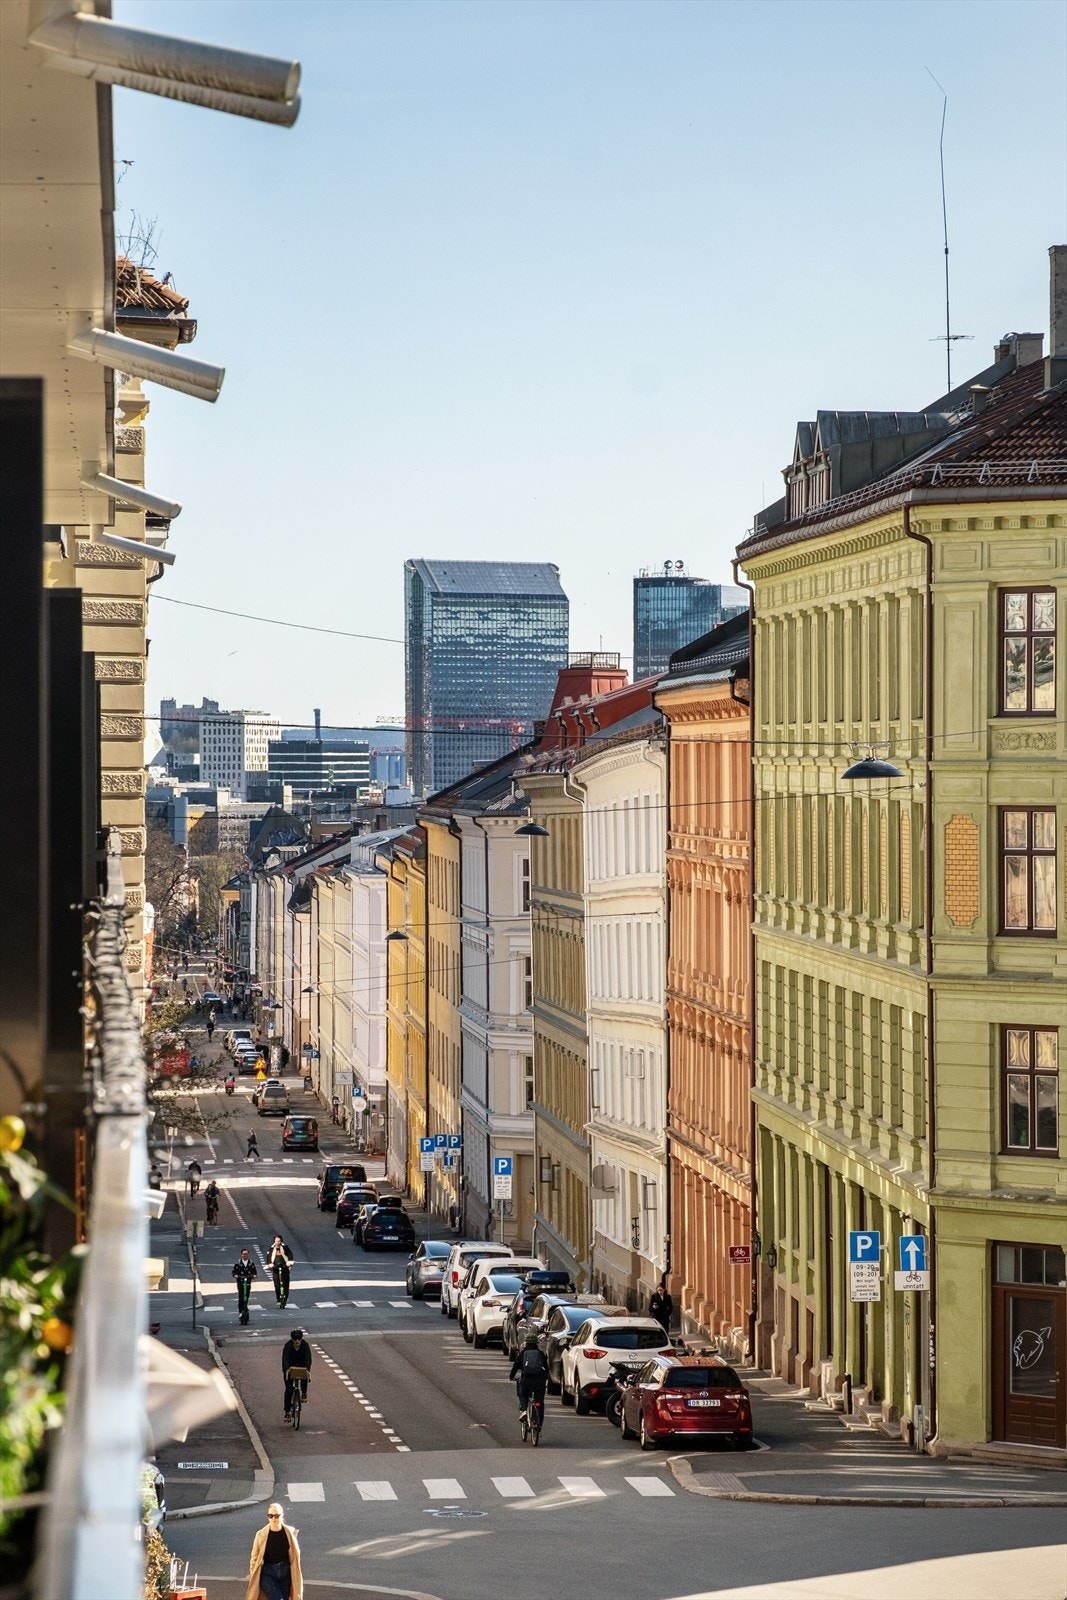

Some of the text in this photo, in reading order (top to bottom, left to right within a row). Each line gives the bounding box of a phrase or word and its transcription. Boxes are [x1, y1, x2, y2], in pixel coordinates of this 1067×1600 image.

[424, 1139, 431, 1150] P
[437, 1135, 444, 1146] P
[451, 1136, 458, 1147] P
[498, 1159, 508, 1173] P
[857, 1236, 872, 1258] P
